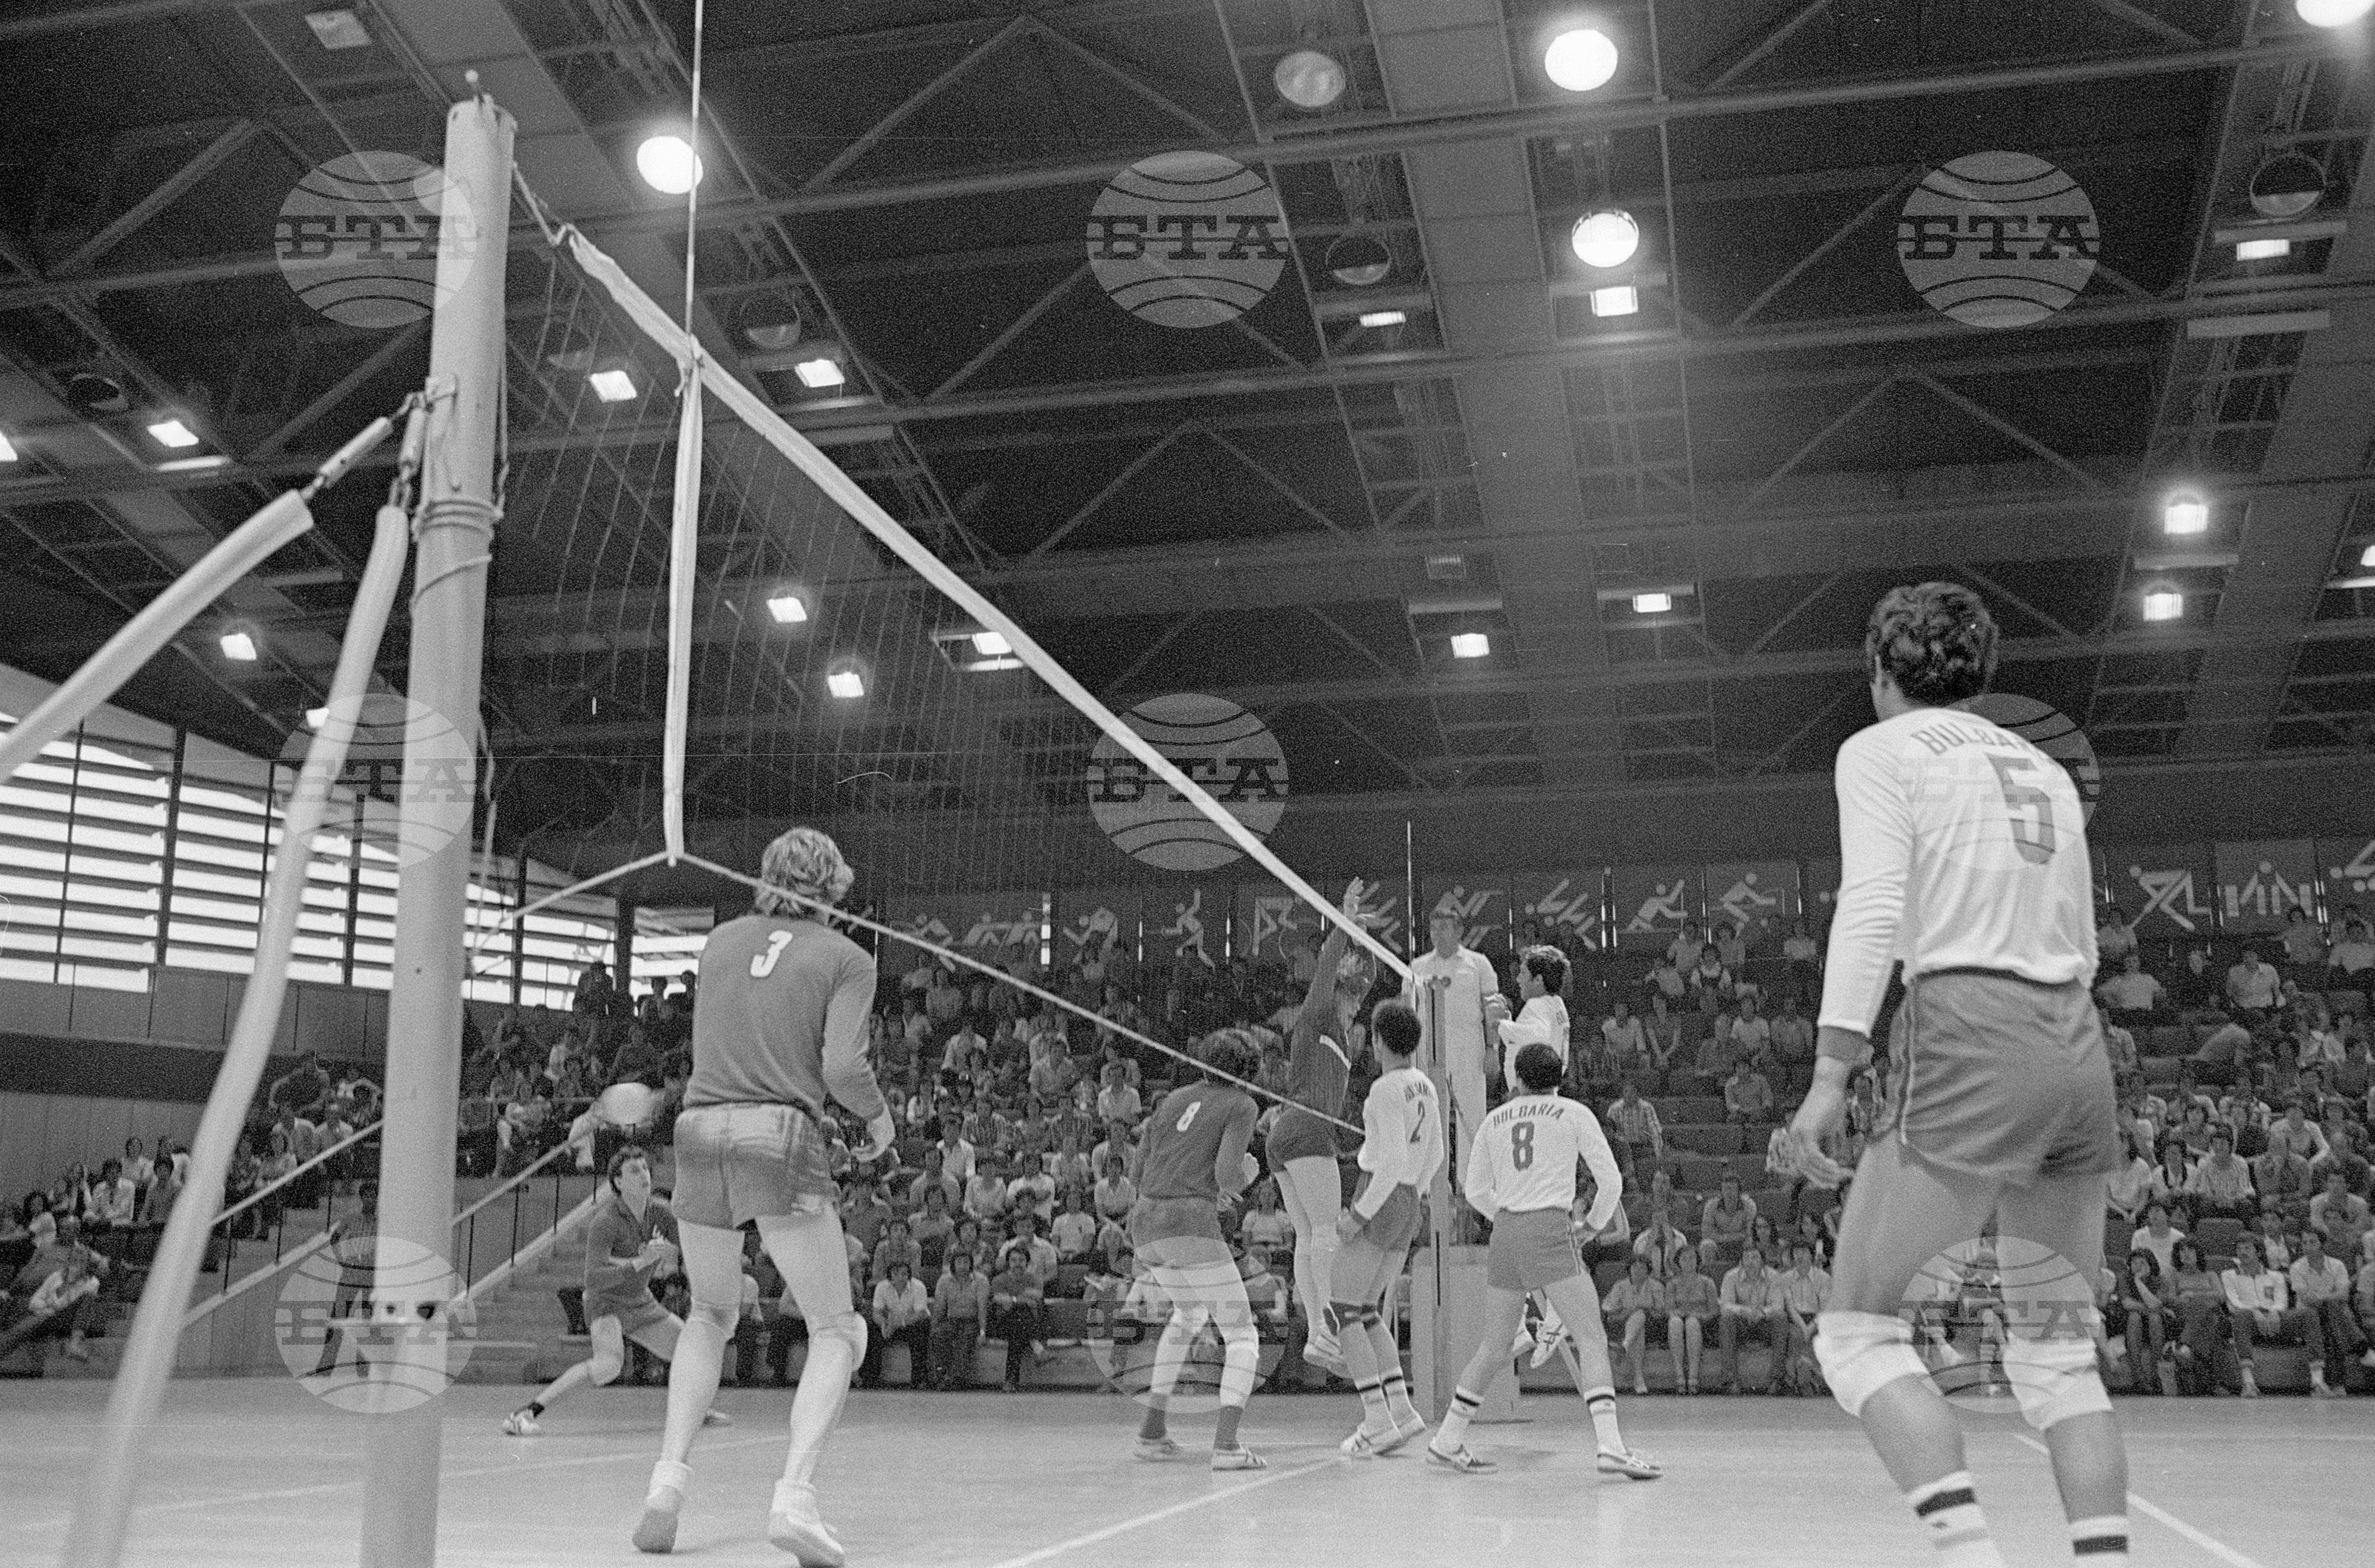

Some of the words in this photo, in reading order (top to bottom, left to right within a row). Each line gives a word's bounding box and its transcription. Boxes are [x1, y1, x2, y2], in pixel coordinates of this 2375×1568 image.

[1984, 752, 2056, 865] 5
[750, 930, 793, 977] 3
[1410, 1101, 1425, 1143] 2
[1493, 1104, 1565, 1127] BULGARIA
[1511, 1122, 1535, 1171] 8
